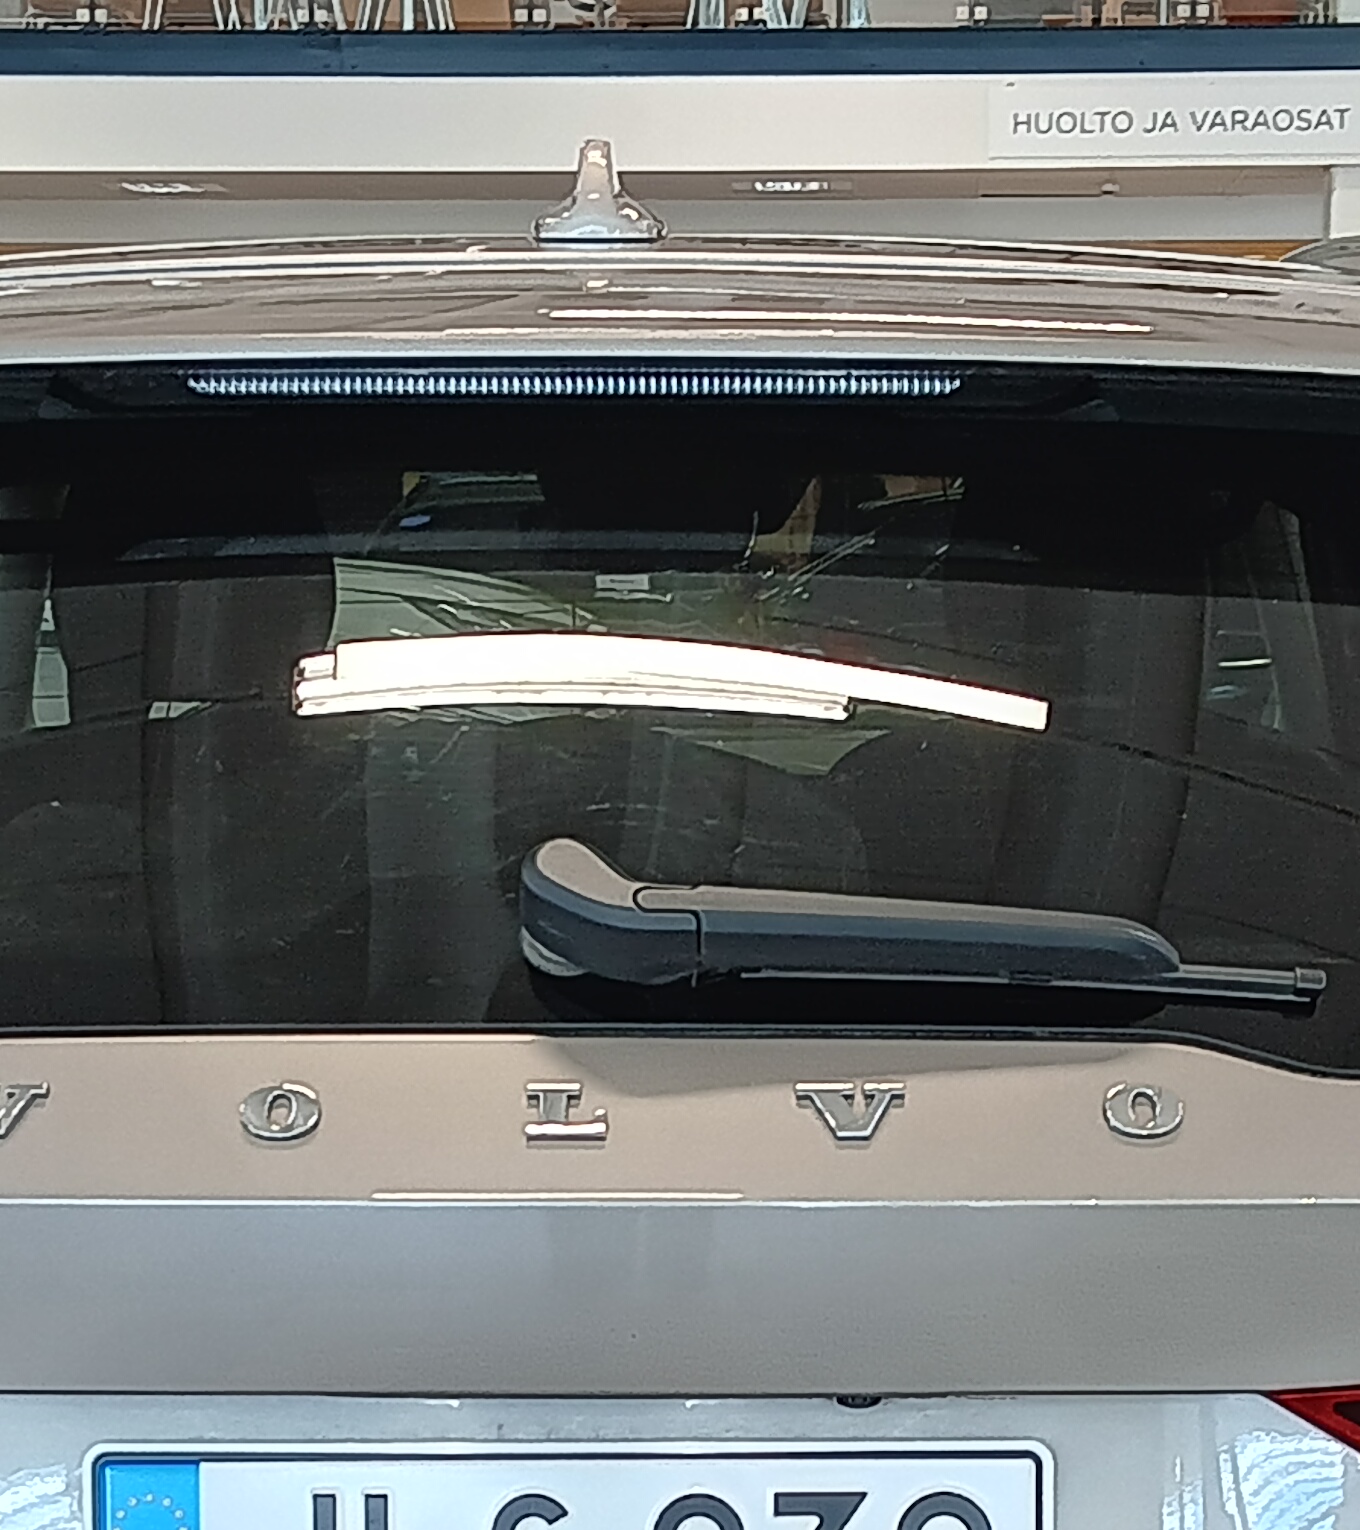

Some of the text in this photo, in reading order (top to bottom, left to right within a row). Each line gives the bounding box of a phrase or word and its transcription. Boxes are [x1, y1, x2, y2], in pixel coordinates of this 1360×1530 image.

[1012, 107, 1351, 136] HUOLTO JA VARAOSAT
